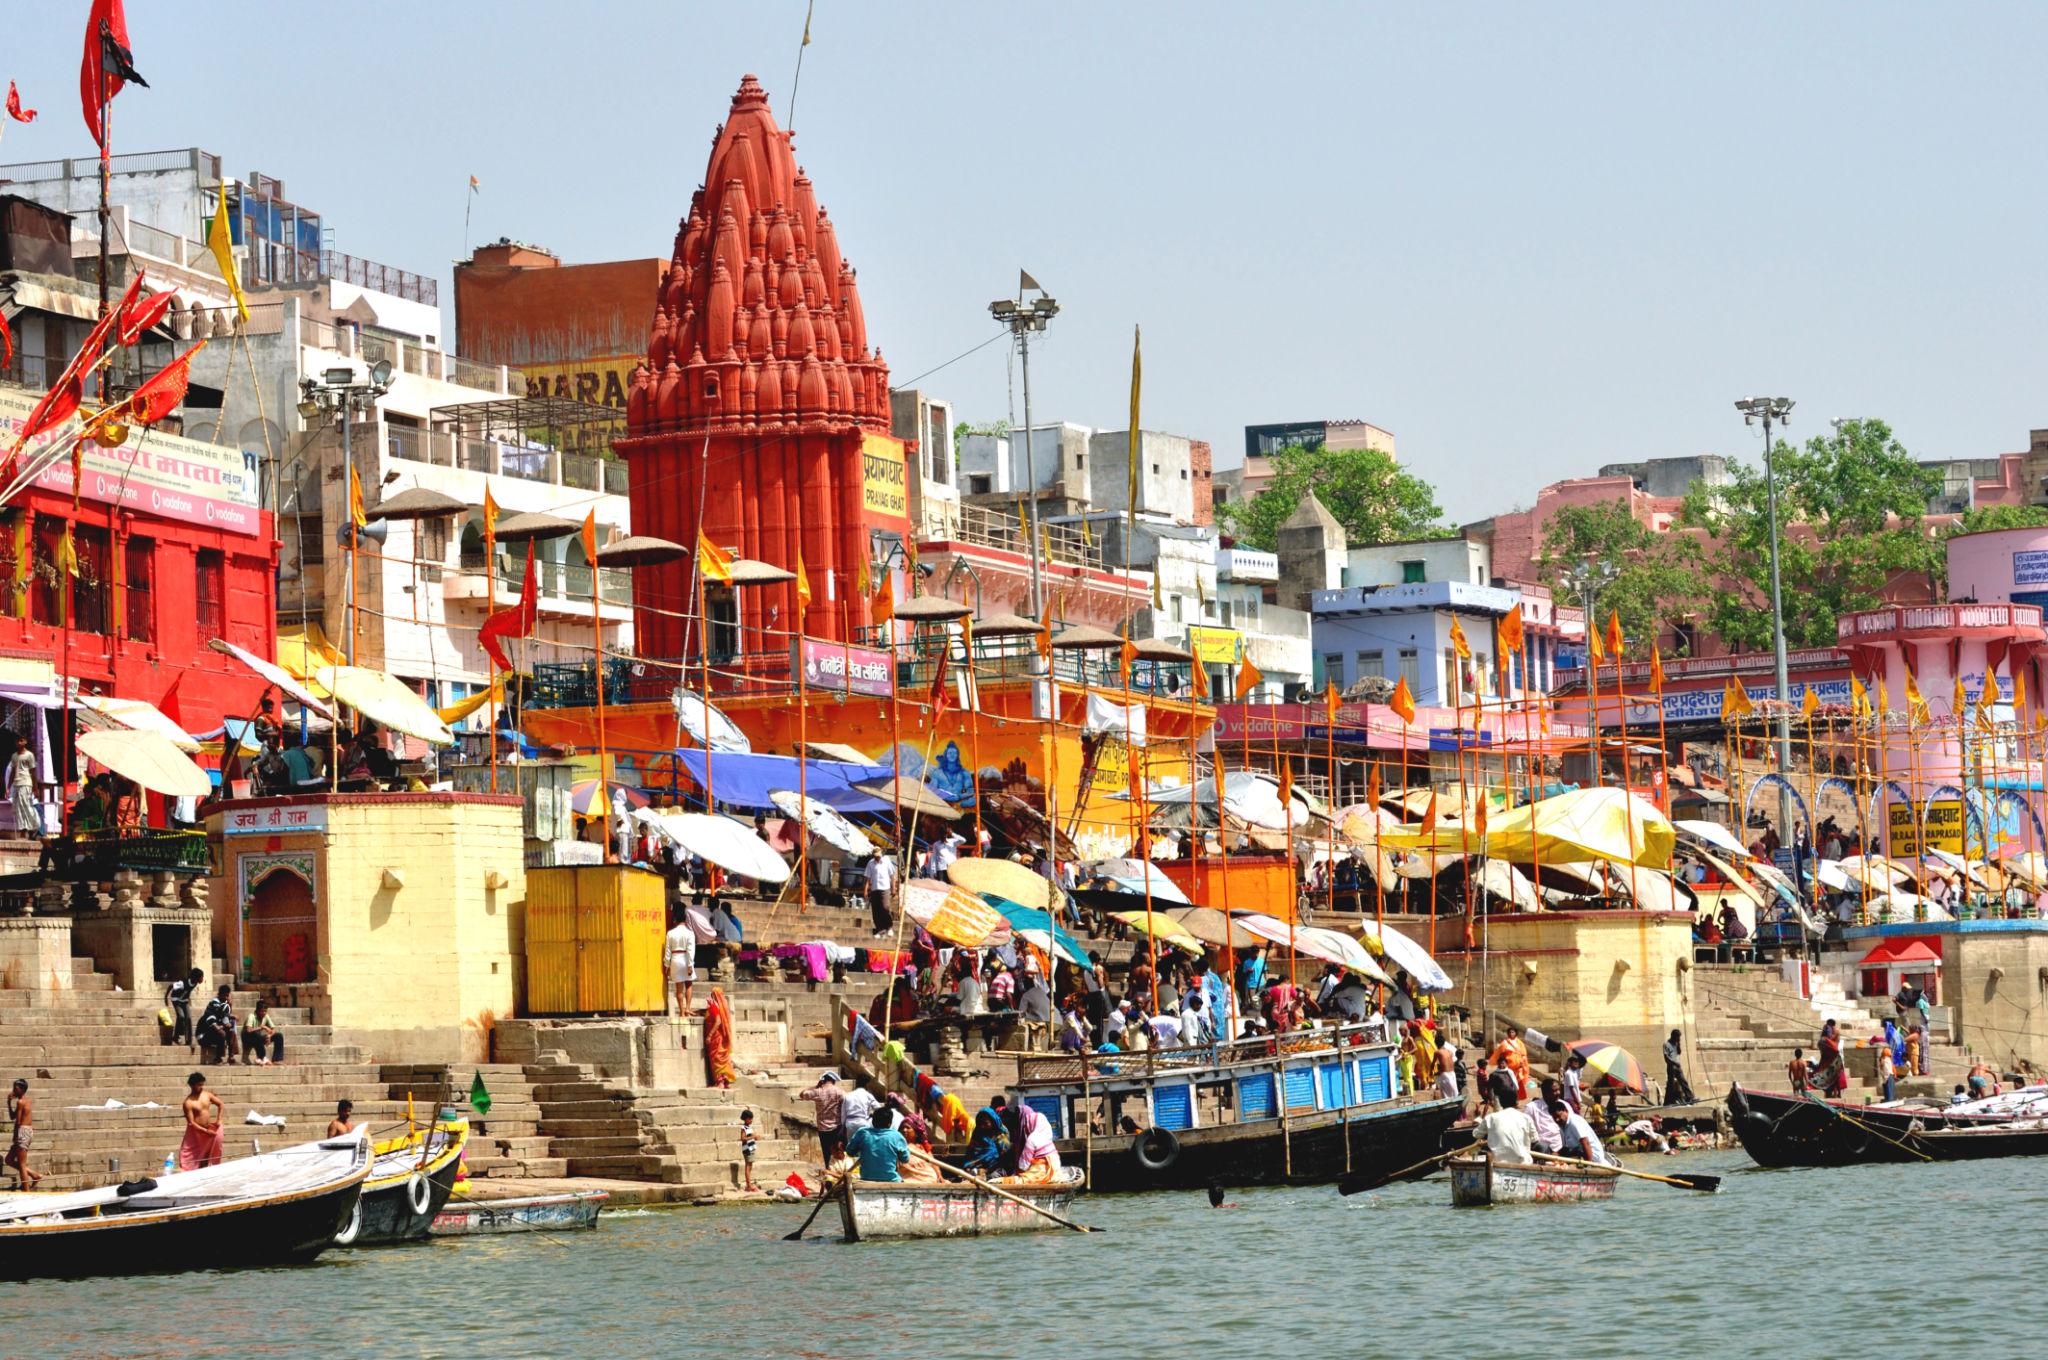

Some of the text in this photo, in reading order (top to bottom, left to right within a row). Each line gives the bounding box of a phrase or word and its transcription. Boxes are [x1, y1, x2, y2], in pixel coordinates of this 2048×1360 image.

[51, 470, 74, 486] vodafo
[156, 454, 222, 485] माता
[863, 452, 904, 486] प्रयाग घाट
[161, 496, 193, 513] vodafone
[866, 488, 905, 512] PRAYAG GHAT
[215, 507, 245, 525] vodafone
[1680, 691, 1710, 710] प्रदेश
[1817, 680, 1848, 697] प्रसाद
[1230, 719, 1293, 733] vodafone
[235, 807, 308, 827] जय श्री राम
[1904, 841, 1941, 854] GT
[1503, 1179, 1518, 1193] 35
